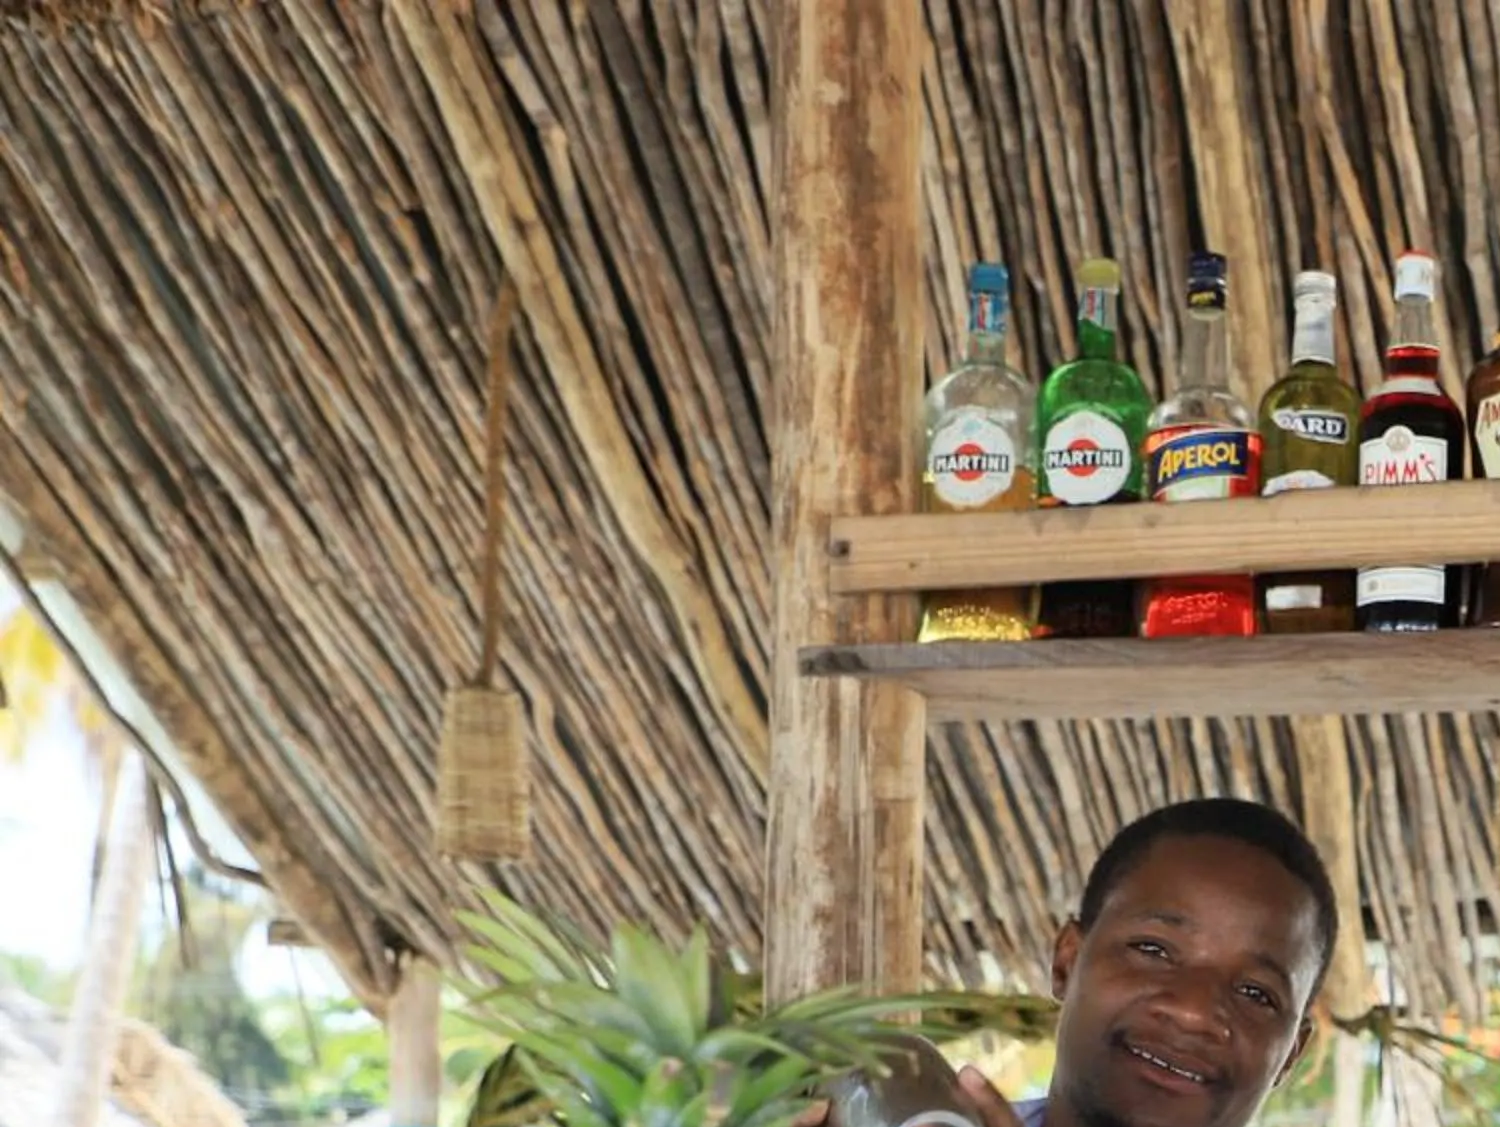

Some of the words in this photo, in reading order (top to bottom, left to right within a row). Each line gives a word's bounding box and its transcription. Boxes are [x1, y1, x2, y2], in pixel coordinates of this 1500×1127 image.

[935, 453, 1009, 473] MARTINI
[1045, 448, 1123, 469] MARTINI
[1158, 441, 1240, 482] APEROL
[1364, 452, 1436, 485] PIMM'S
